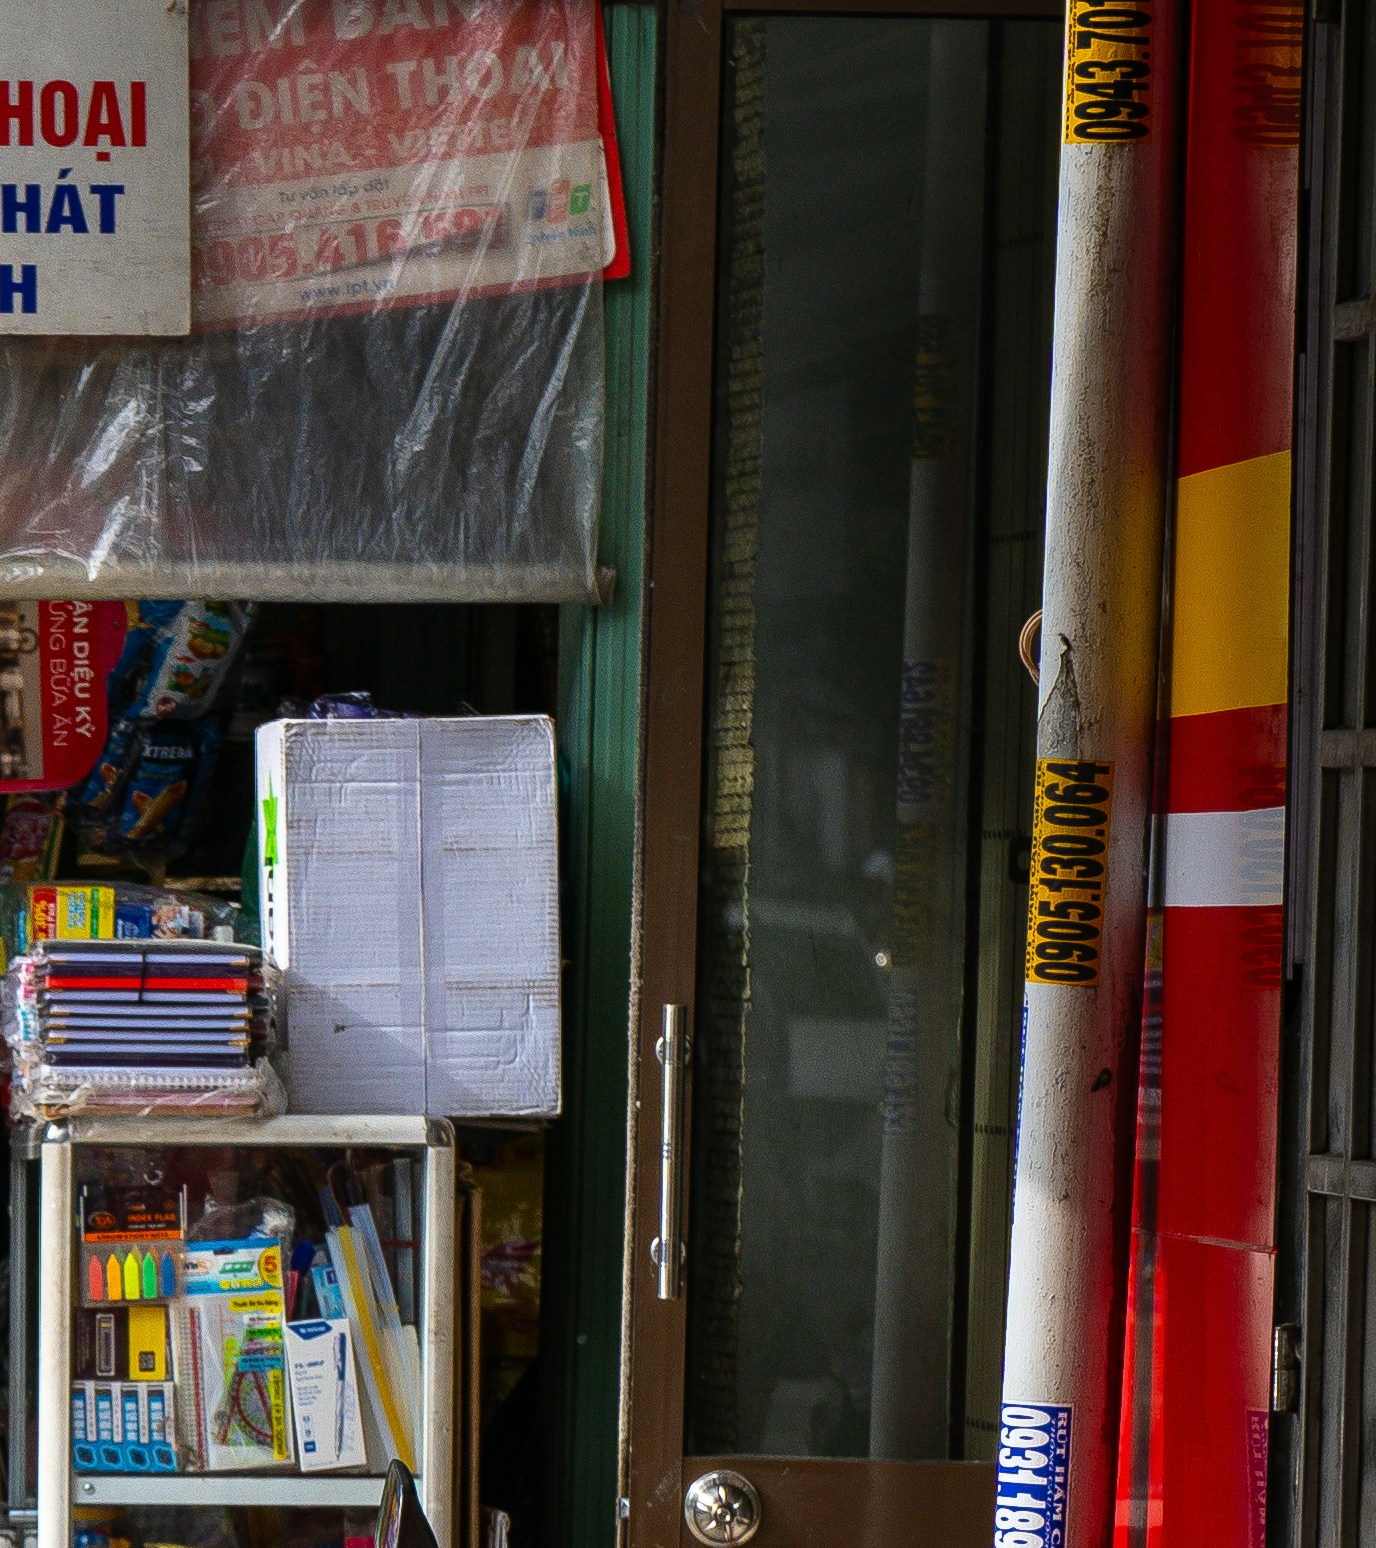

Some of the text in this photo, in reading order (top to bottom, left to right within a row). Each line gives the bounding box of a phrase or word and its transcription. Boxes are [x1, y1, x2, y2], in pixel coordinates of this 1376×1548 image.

[234, 61, 372, 133] ĐIỆN
[49, 659, 71, 706] BỮA
[70, 641, 95, 698] DIỆU
[51, 713, 73, 747] ĂN
[1033, 761, 1111, 982] 0905.130.064
[1055, 1411, 1068, 1460] RÚT
